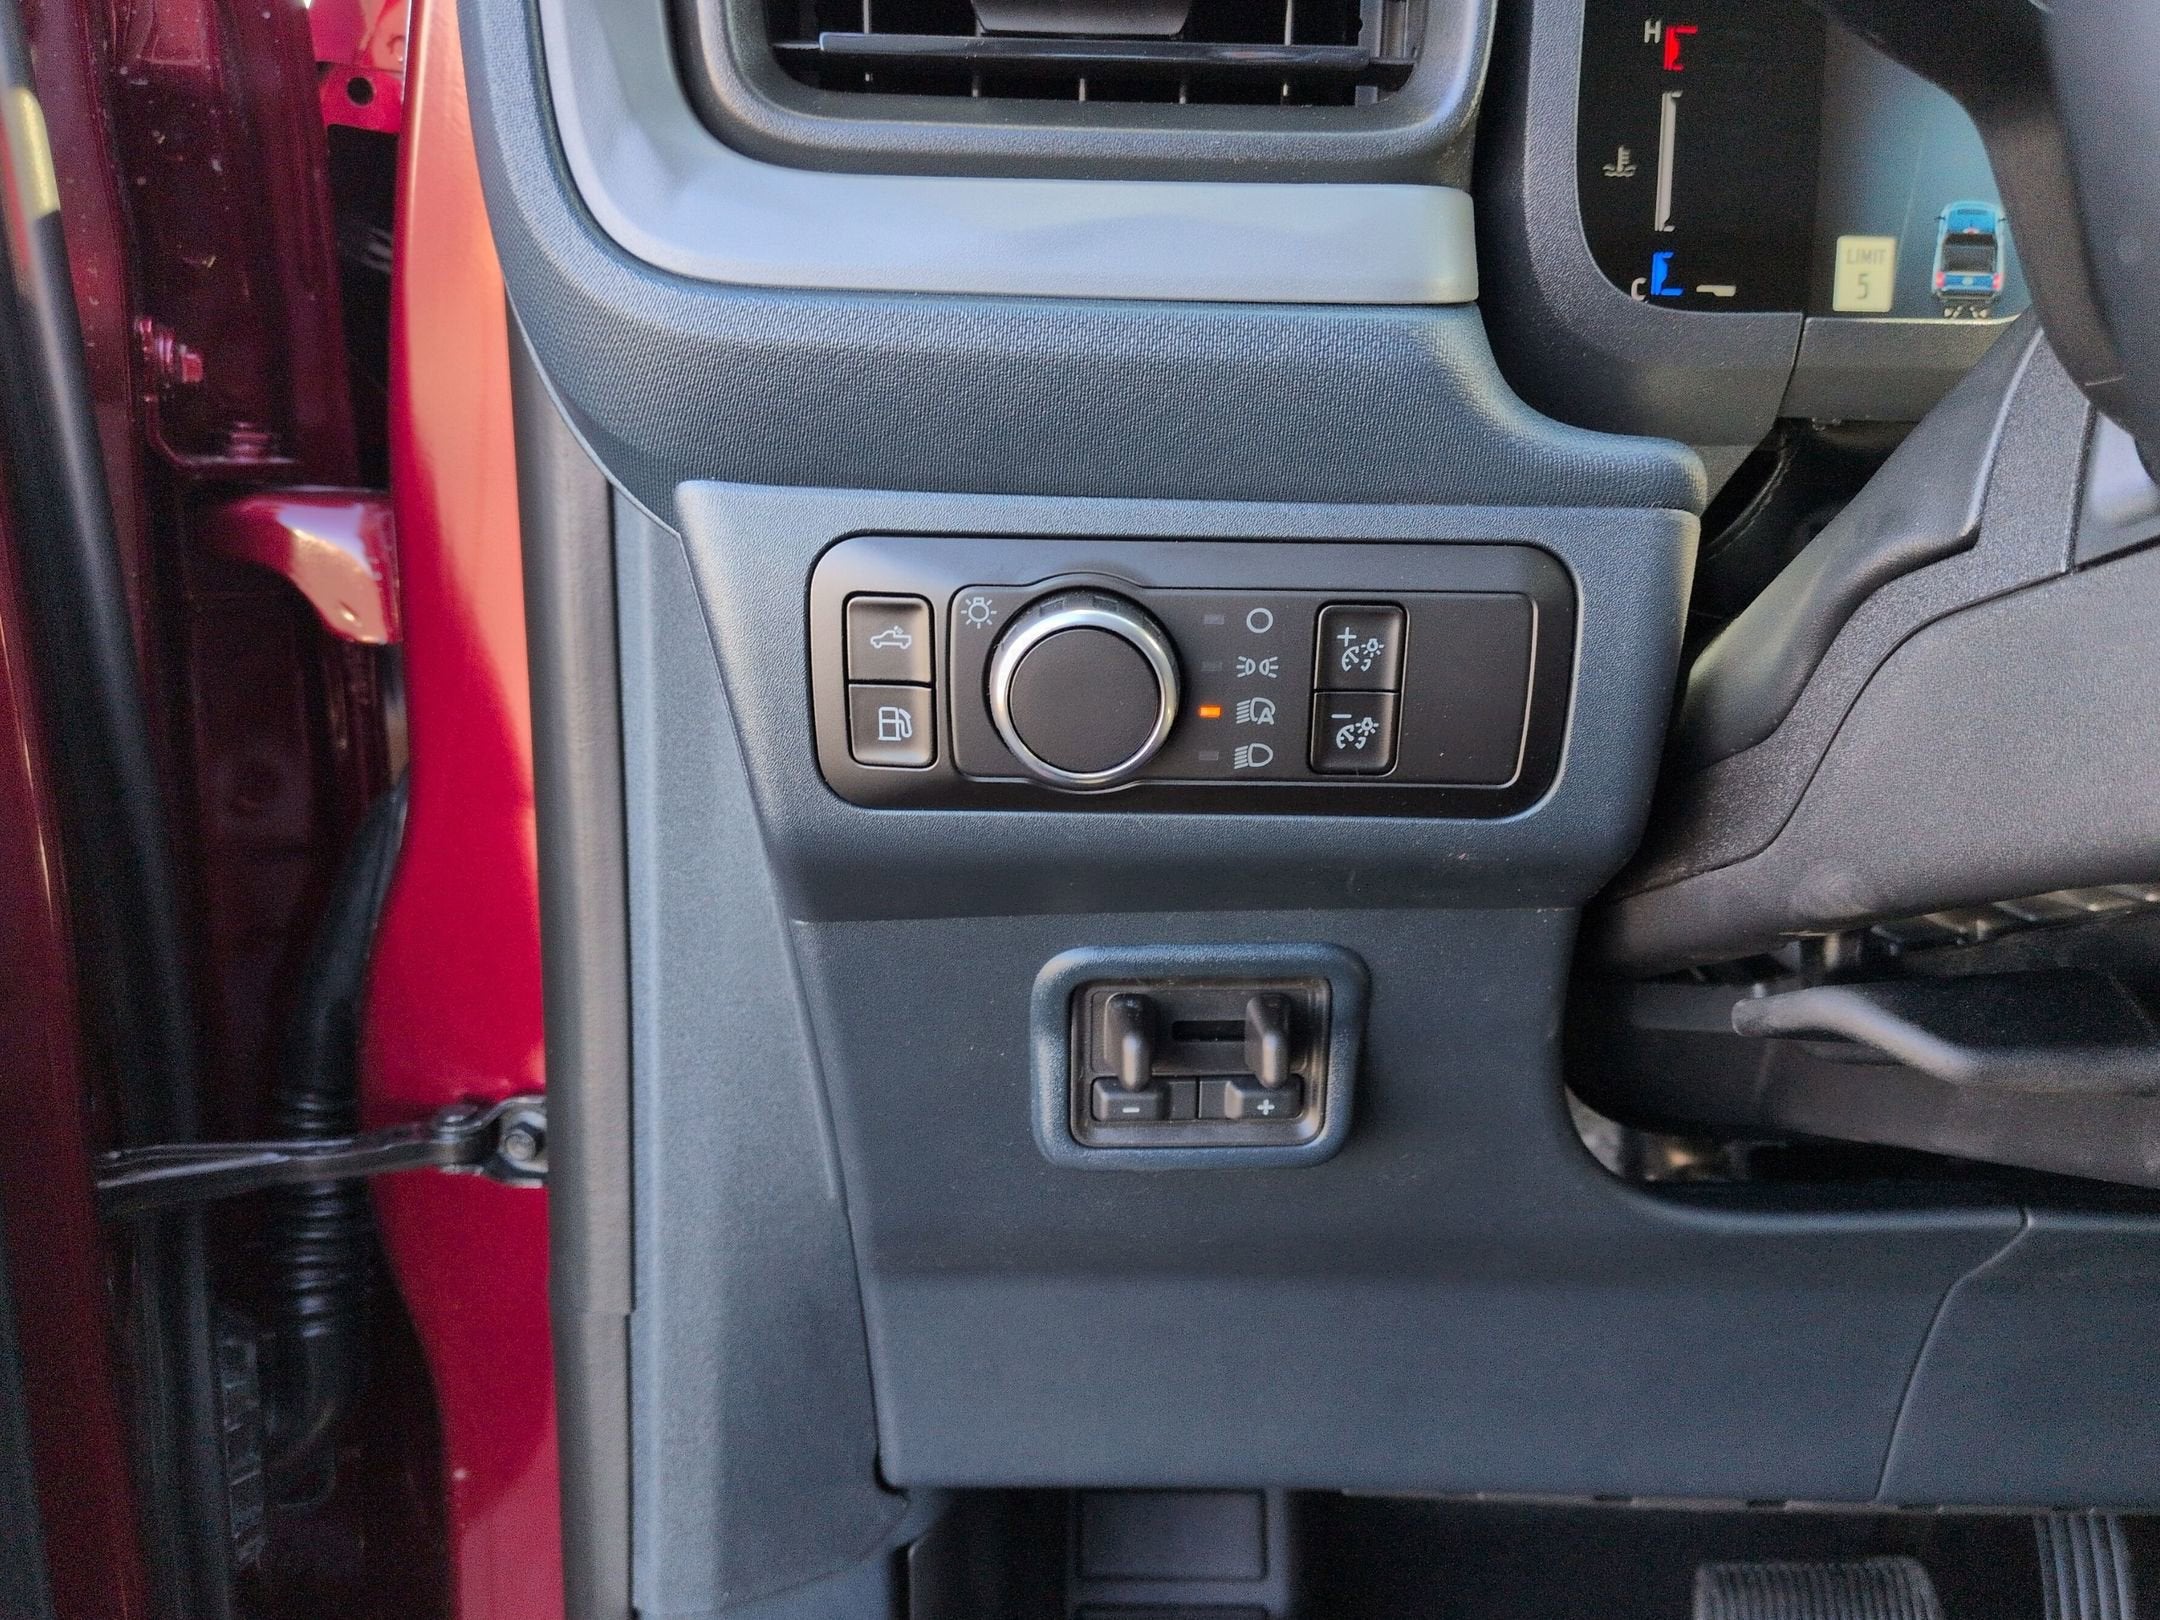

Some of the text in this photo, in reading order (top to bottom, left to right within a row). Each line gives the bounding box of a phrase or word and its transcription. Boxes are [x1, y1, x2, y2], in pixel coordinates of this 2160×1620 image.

[1644, 19, 1661, 43] H
[1846, 248, 1887, 265] LIMIT
[1631, 277, 1647, 301] C
[1856, 272, 1869, 300] 5
